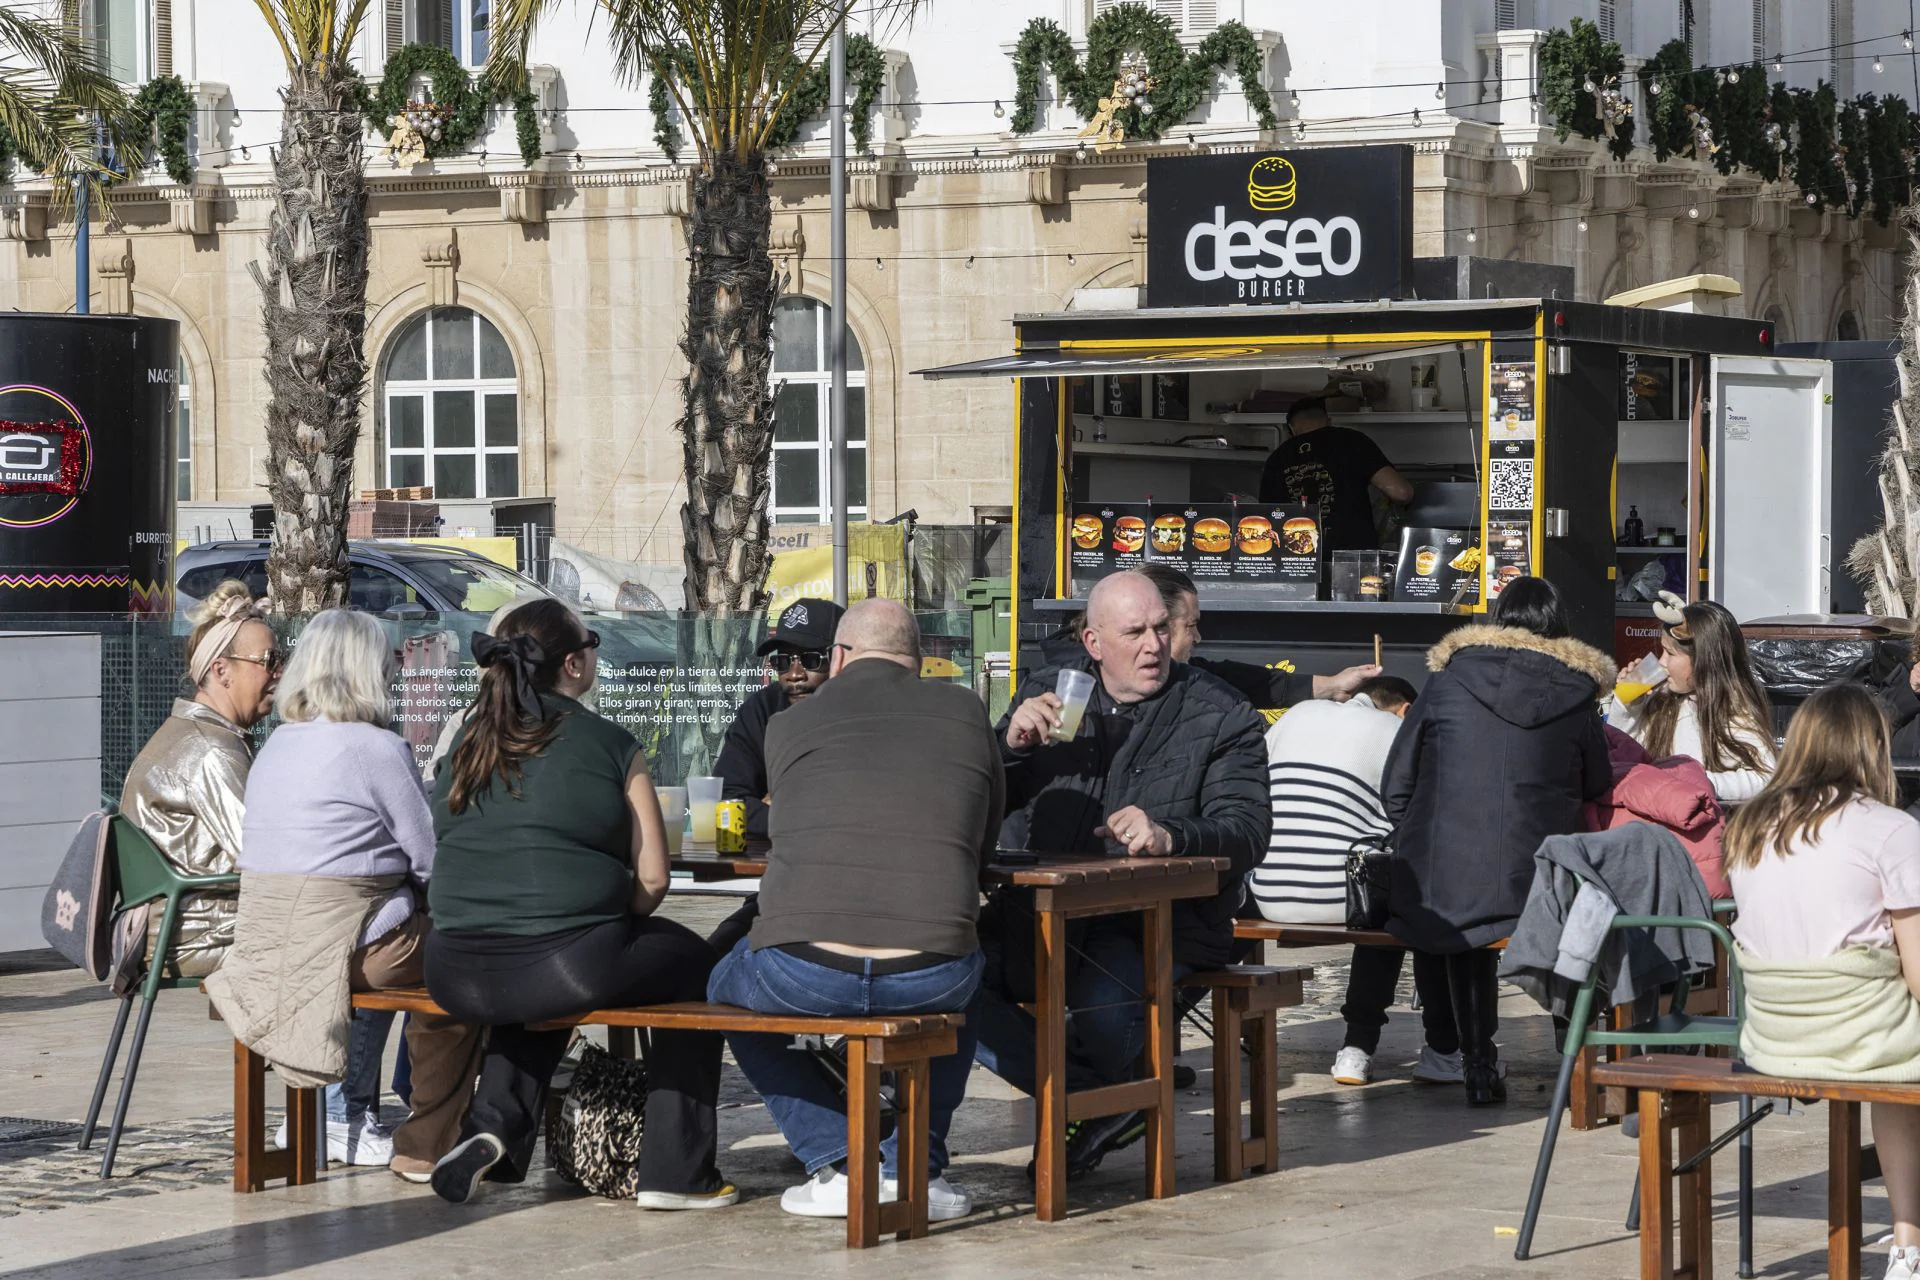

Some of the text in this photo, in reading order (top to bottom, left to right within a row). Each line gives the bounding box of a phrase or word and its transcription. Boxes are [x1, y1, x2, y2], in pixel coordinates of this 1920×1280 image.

[1185, 205, 1361, 281] deseo
[1238, 279, 1305, 298] BURGER
[6, 472, 54, 482] CALLEJERA
[135, 532, 172, 544] BURRITOS
[420, 666, 457, 678] ángeles
[599, 667, 626, 679] Agua
[630, 666, 656, 677] dulce
[660, 669, 673, 677] en
[676, 666, 685, 677] la
[688, 666, 716, 677] tierra
[720, 666, 732, 677] de
[412, 684, 430, 693] que
[434, 683, 444, 691] te
[600, 684, 624, 694] agua
[628, 684, 634, 694] y
[637, 682, 650, 692] sol
[654, 684, 666, 692] en
[670, 683, 685, 692] tus
[689, 681, 721, 692] límites
[416, 697, 446, 706] ebrios
[450, 697, 462, 706] de
[600, 697, 622, 707] Ellos
[625, 697, 651, 709] giran
[655, 700, 660, 709] y
[664, 697, 693, 709] giran;
[697, 700, 731, 709] remos,
[425, 712, 440, 721] del
[616, 713, 646, 722] timón
[650, 714, 672, 725] -que
[676, 715, 697, 723] eres
